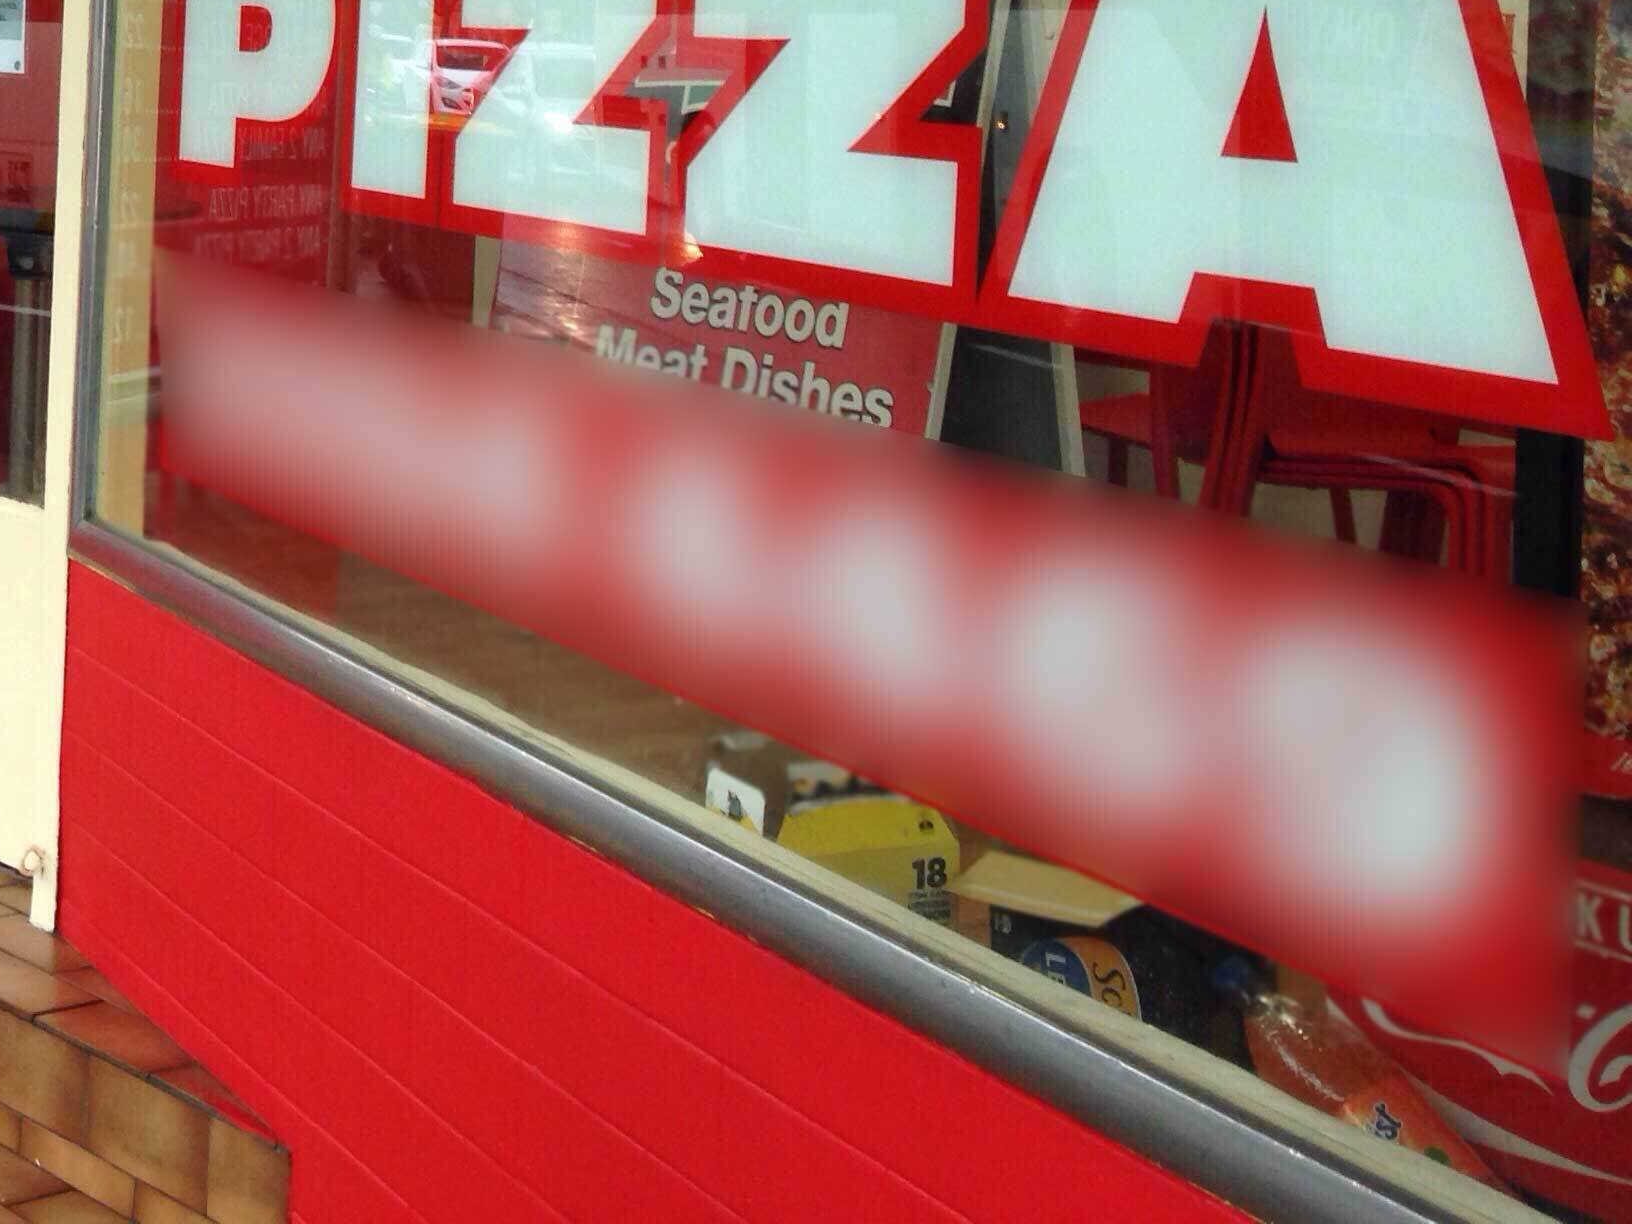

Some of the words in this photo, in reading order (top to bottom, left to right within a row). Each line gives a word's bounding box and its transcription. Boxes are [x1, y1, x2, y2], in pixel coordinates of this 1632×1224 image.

[651, 266, 849, 349] Seafood
[595, 322, 707, 381] Meat
[721, 346, 894, 428] Dishes
[912, 856, 947, 890] 18
